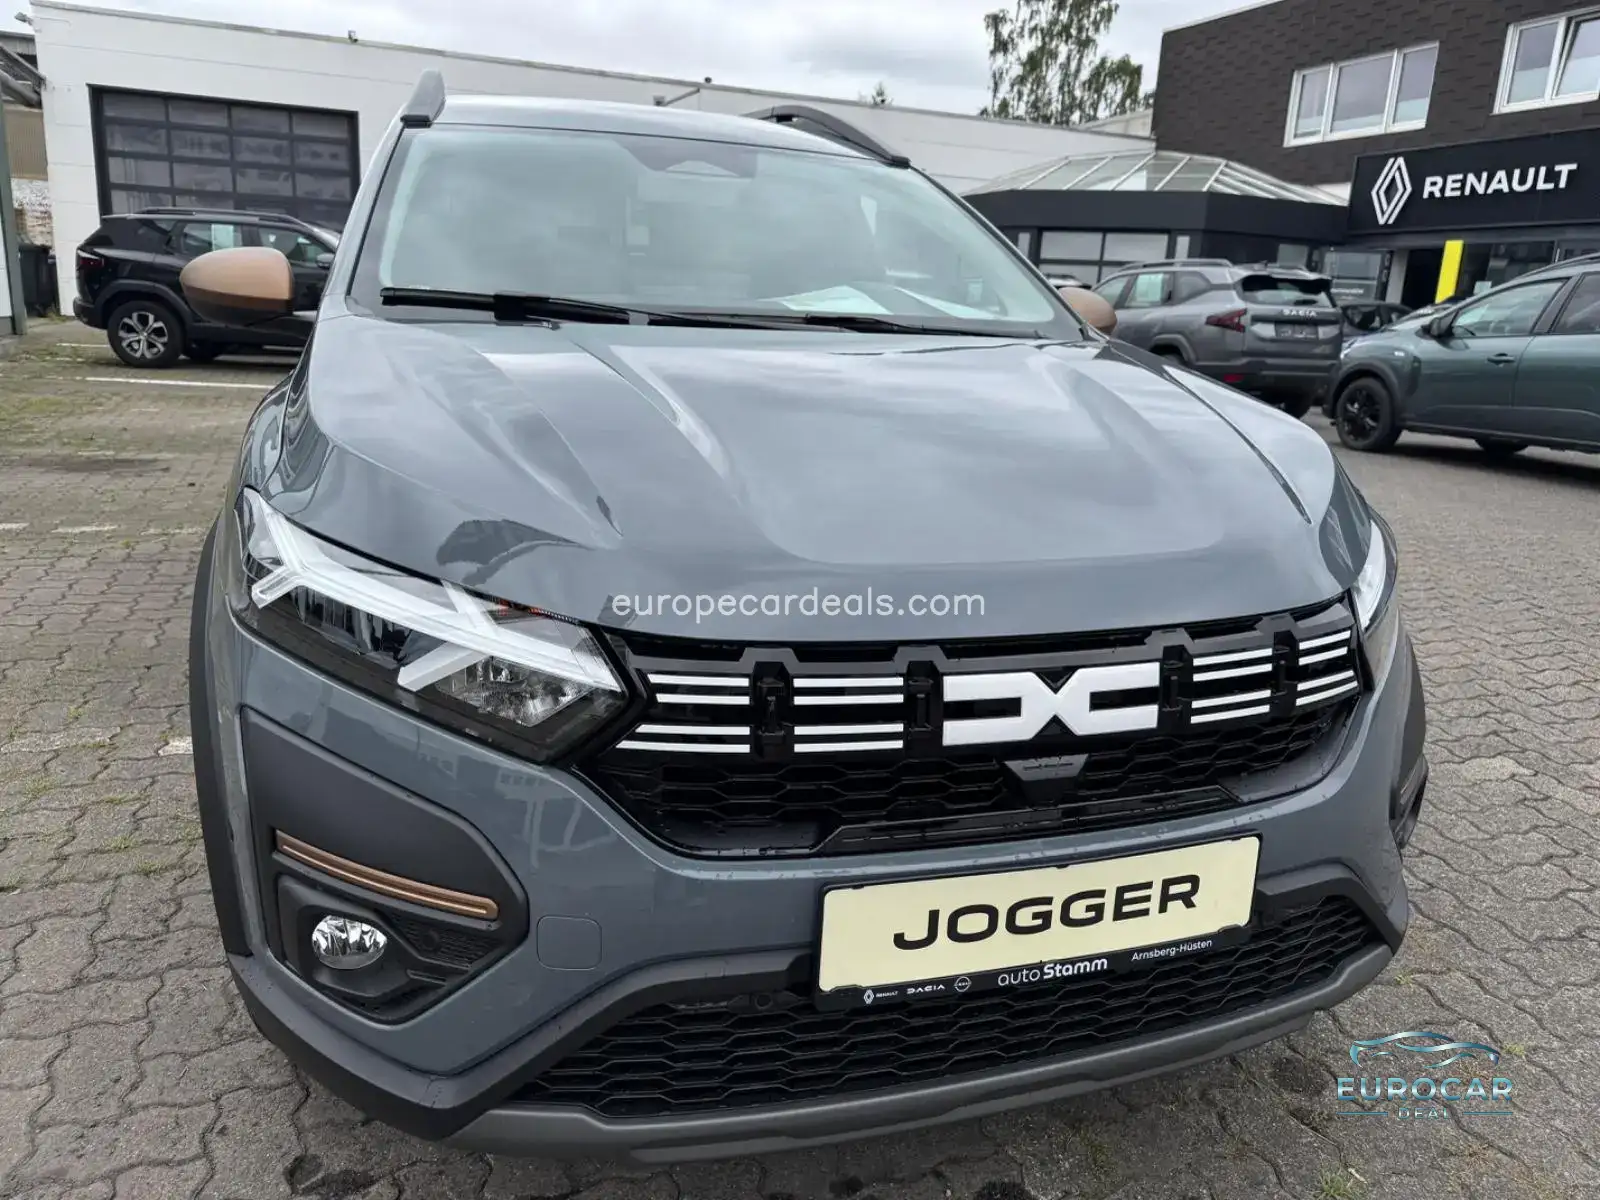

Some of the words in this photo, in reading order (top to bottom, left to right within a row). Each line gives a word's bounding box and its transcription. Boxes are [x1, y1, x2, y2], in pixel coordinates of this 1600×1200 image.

[1422, 162, 1578, 199] RENAULT
[892, 873, 1201, 951] JOGGER
[906, 983, 946, 995] DACIA
[997, 967, 1041, 986] auto
[1043, 957, 1108, 979] Stamm
[1131, 938, 1213, 962] Arnsberg-Hüsten
